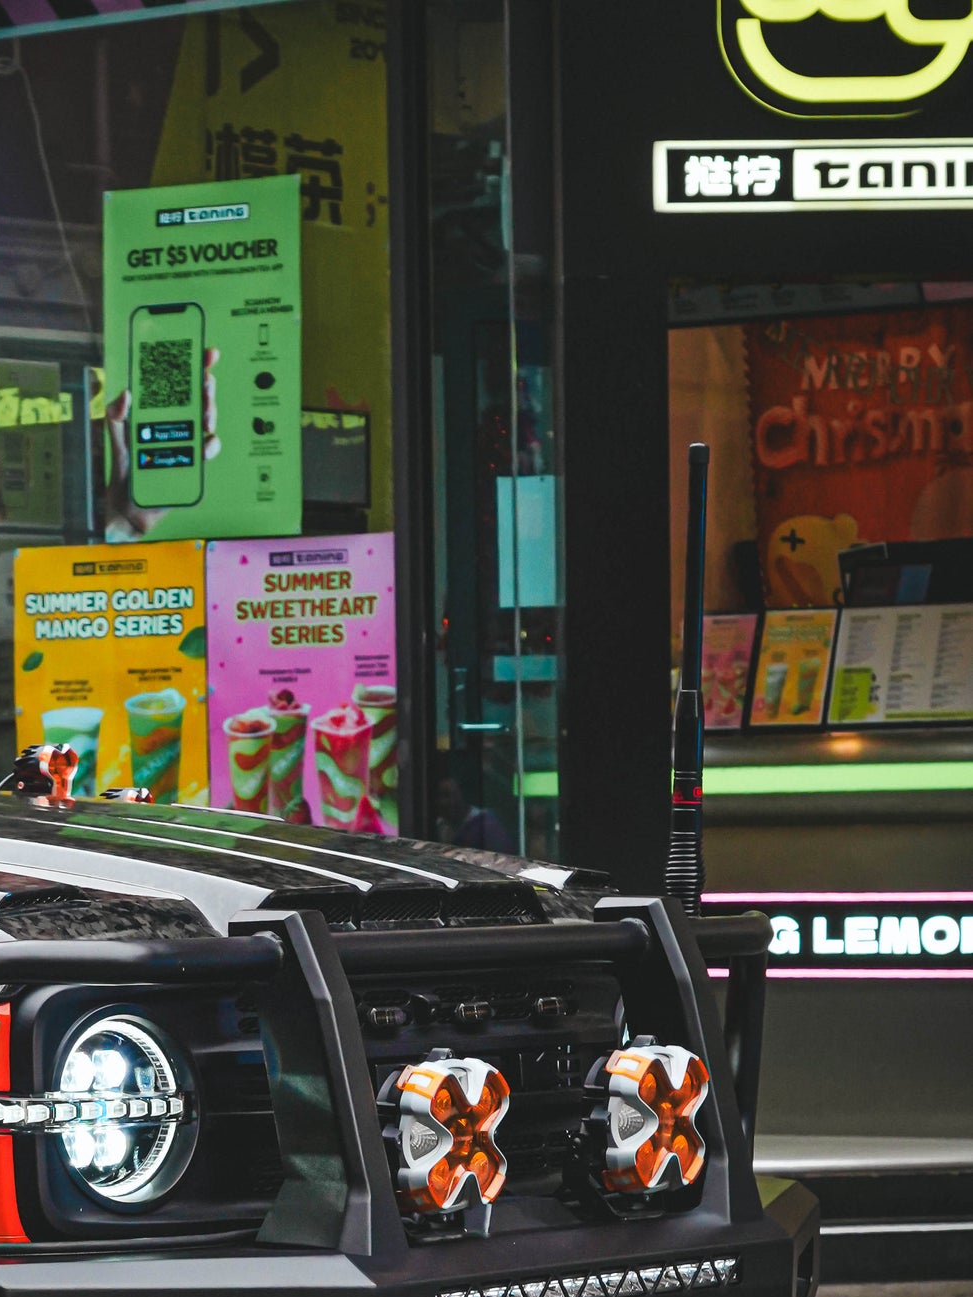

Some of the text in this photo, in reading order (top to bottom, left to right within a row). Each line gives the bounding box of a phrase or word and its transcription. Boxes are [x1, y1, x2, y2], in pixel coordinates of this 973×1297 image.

[127, 238, 279, 268] GET $5 VOUCHER
[264, 570, 352, 593] SUMMER
[25, 586, 194, 614] SUMMER GOLDEN
[235, 595, 378, 621] SWEETHEART
[35, 613, 184, 640] MANGO SERIES
[270, 624, 345, 646] SERIES
